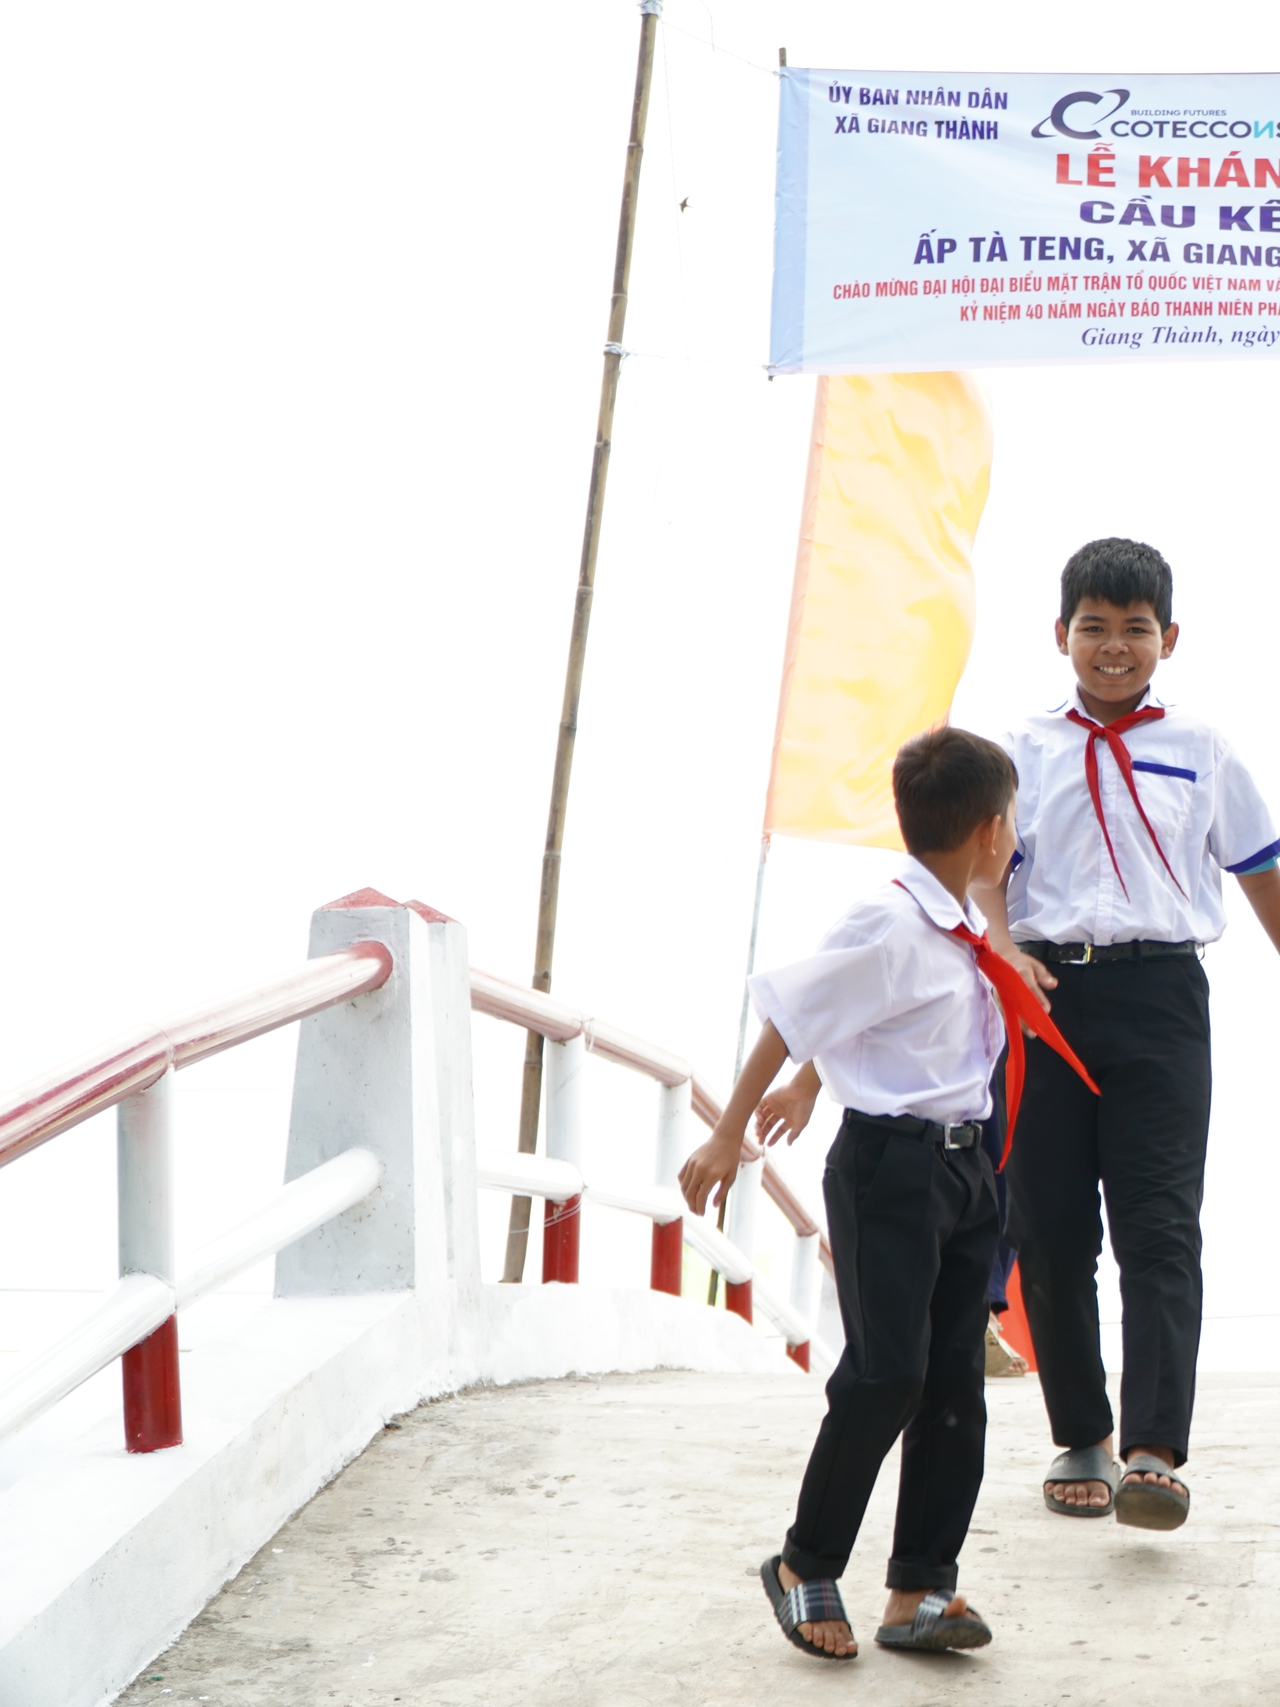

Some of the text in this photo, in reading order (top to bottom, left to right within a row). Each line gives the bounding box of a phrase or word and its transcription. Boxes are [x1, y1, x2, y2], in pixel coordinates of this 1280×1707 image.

[827, 80, 1008, 110] ỦY BAN NHÂN DÂN
[834, 113, 998, 140] XÃ GIANG THÀNH
[1131, 109, 1227, 117] BUILDING FUTURES
[1055, 142, 1117, 187] LỄ
[1080, 195, 1196, 228] CẦU
[913, 228, 957, 264] ẤP
[969, 231, 1009, 262] TÀ
[1020, 235, 1114, 264] TENG,
[1126, 236, 1171, 262] XÃ
[832, 279, 870, 299] CHÀO
[875, 278, 918, 297] MỪNG
[923, 279, 947, 298] ĐẠI
[951, 275, 975, 298] HỘI
[980, 277, 1004, 297] ĐẠI
[1009, 270, 1042, 293] BIỂU
[1047, 272, 1078, 294] MẶT
[1083, 272, 1121, 293] TRẬN
[1126, 270, 1143, 290] TỔ
[1148, 271, 1187, 291] QUỐC
[1192, 275, 1222, 293] VIỆT
[1227, 278, 1261, 291] NAM
[983, 301, 1021, 324] NIỆM
[1025, 303, 1043, 319] 40
[1048, 299, 1082, 318] NĂM
[1087, 298, 1126, 318] NGÀY
[1131, 298, 1160, 317] BÁO
[1165, 301, 1213, 316] THANH
[1218, 298, 1253, 316] NIÊN
[1081, 327, 1143, 349] Giang
[1151, 326, 1224, 347] Thành,
[1230, 326, 1280, 348] ngày
